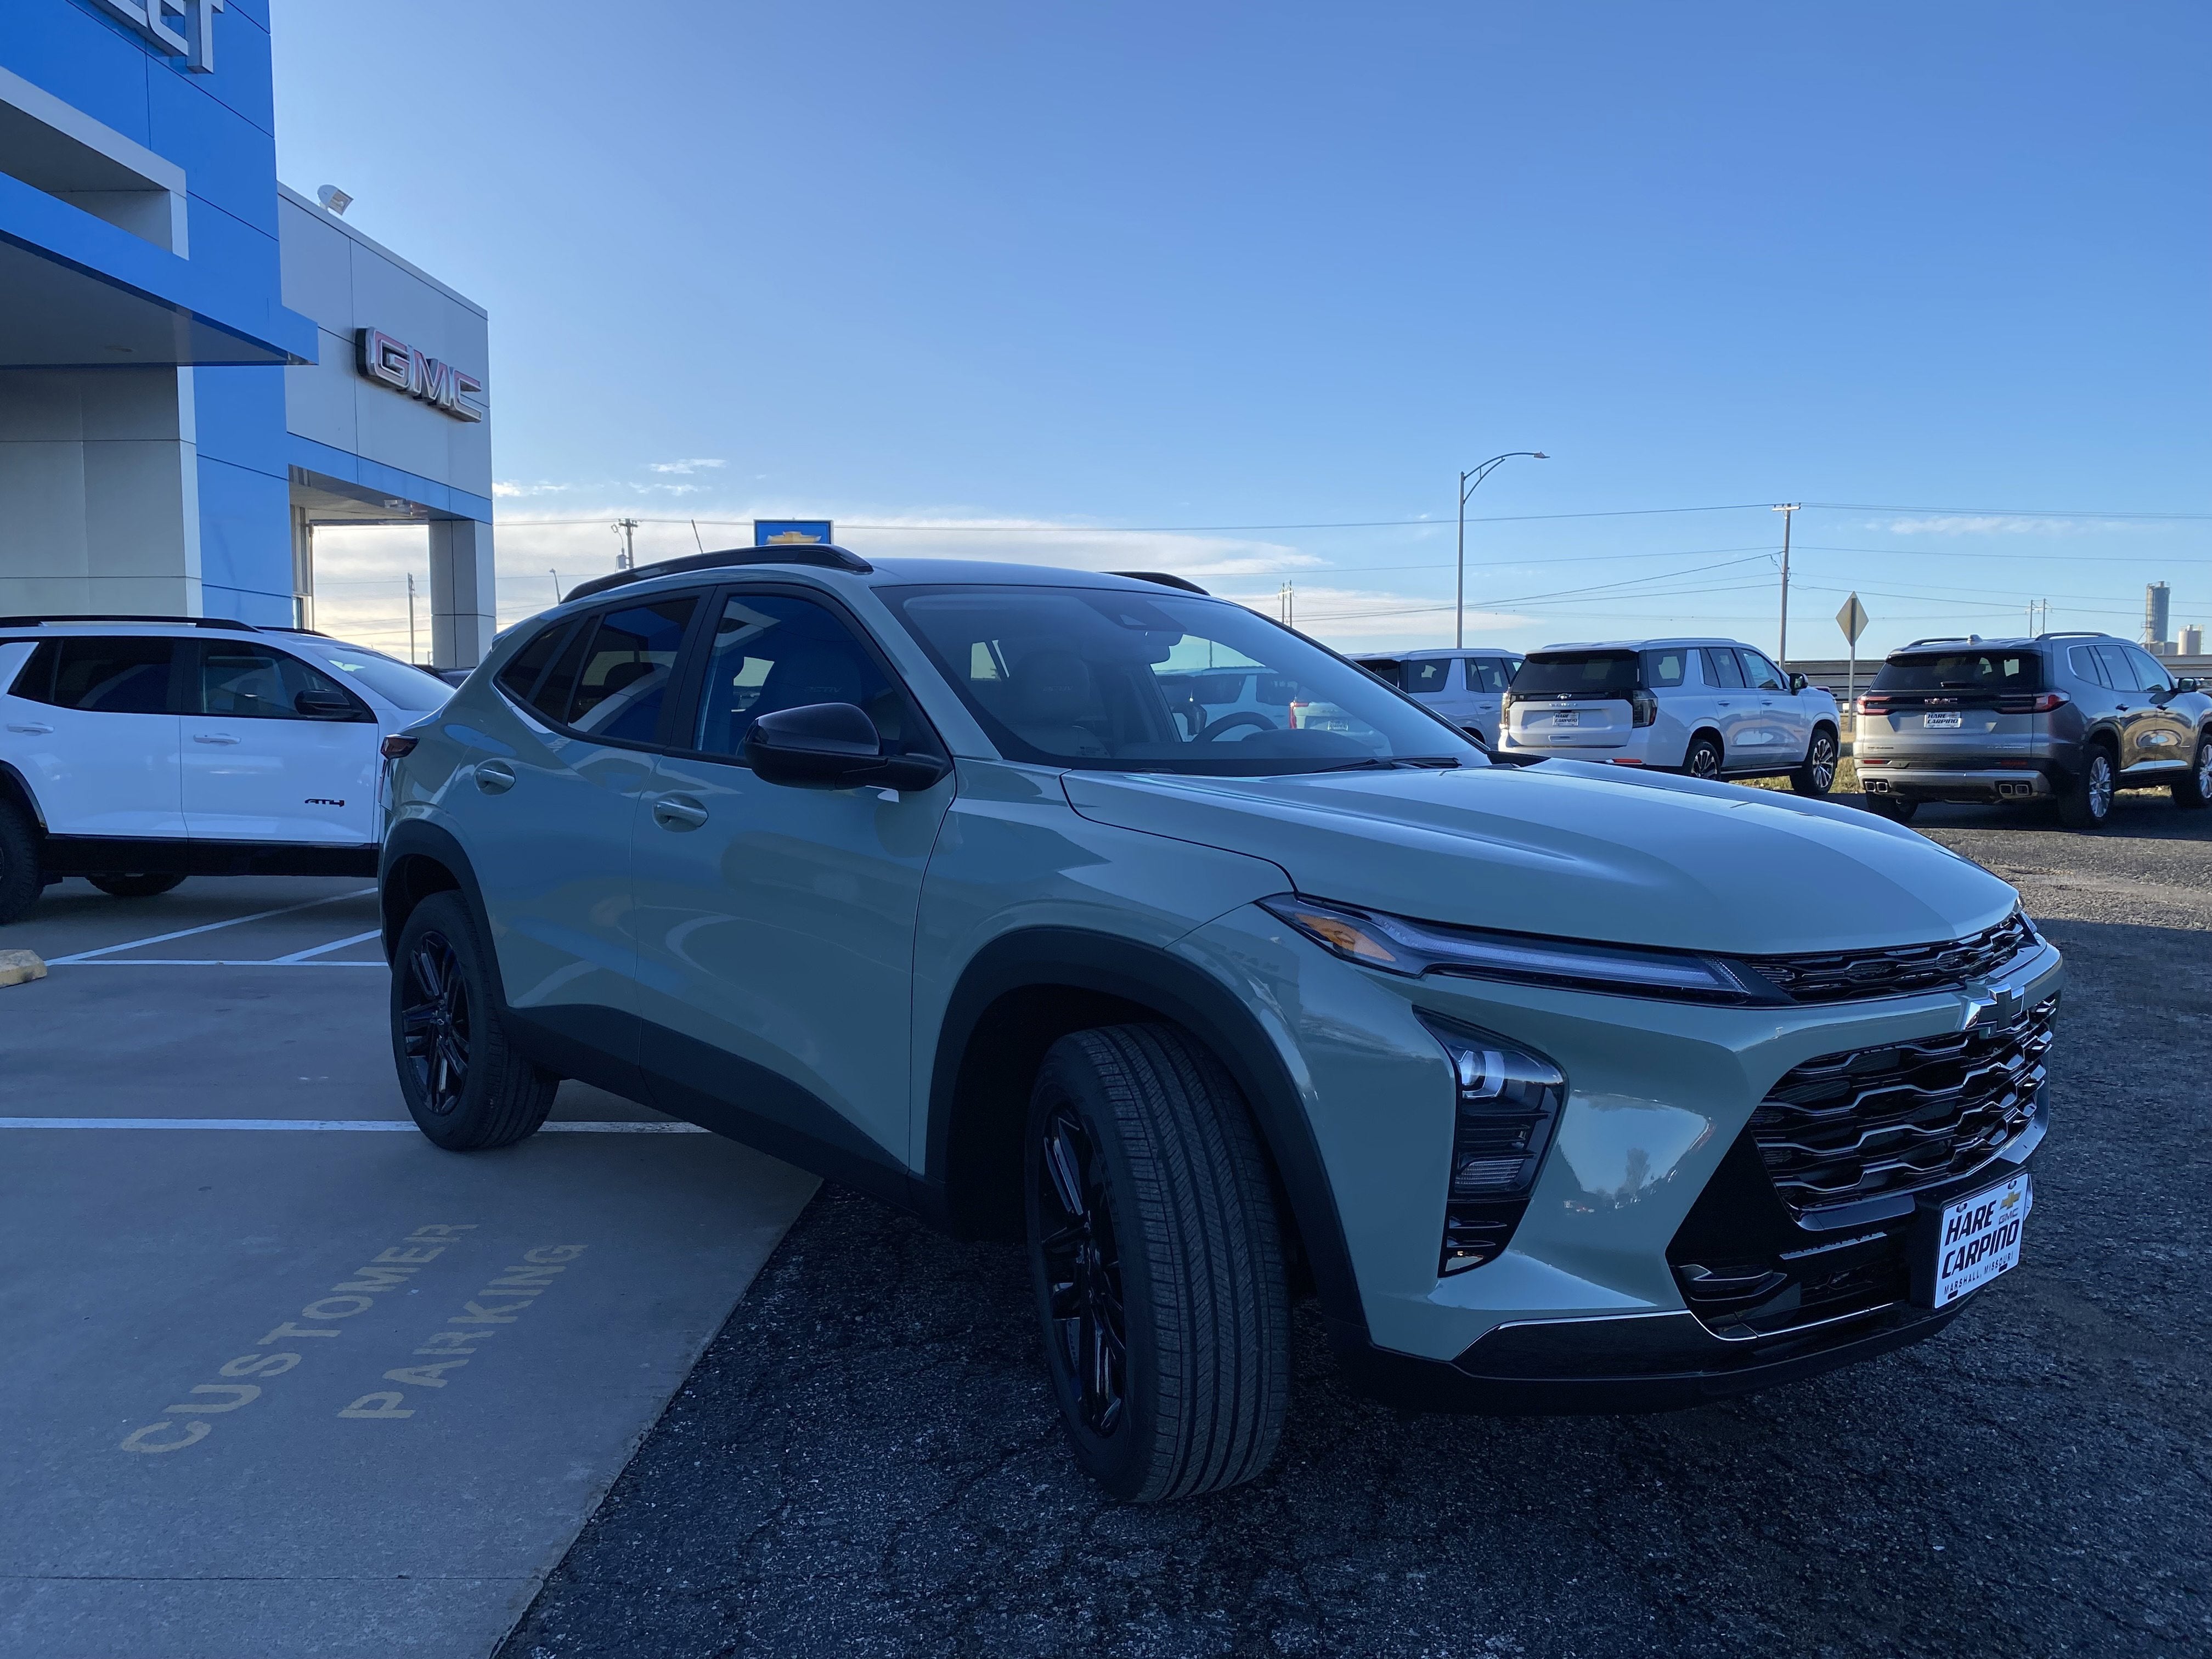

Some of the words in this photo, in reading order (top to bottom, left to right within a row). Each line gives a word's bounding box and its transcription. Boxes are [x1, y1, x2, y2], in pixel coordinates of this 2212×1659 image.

[361, 327, 483, 423] GMC
[1944, 1200, 1997, 1246] HARE
[1999, 1207, 2019, 1224] GMC
[1942, 1218, 2020, 1279] CARPINO
[1944, 1269, 1982, 1295] MARSHALL,
[1984, 1251, 2014, 1275] MISSOURI
[120, 1223, 482, 1454] CUSTOMER
[337, 1244, 590, 1419] PARKING
